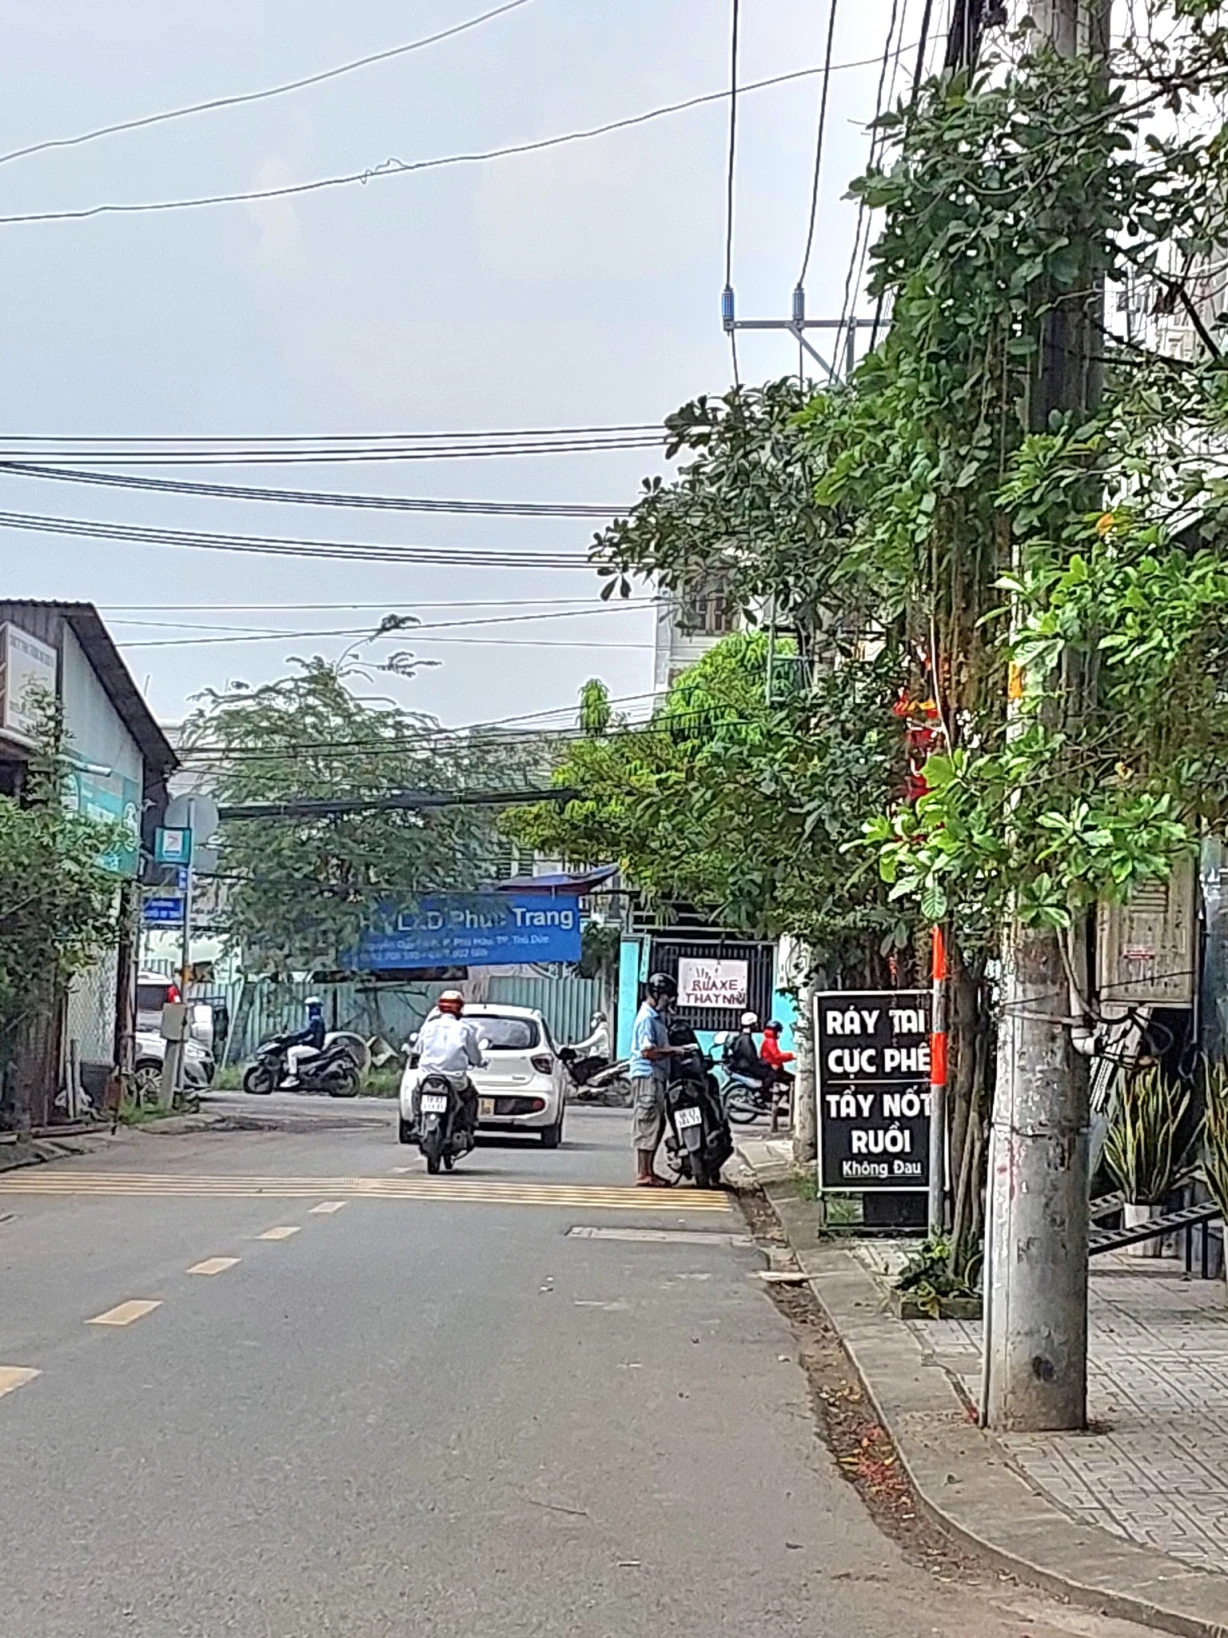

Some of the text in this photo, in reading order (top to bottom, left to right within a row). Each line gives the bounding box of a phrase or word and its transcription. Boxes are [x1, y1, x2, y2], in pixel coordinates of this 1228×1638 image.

[512, 908, 573, 930] Trang
[826, 1005, 926, 1034] RÁY TAI
[828, 1042, 931, 1079] CỰC PHÊ
[825, 1085, 931, 1118] TẨY NỐT
[851, 1121, 911, 1154] RUỒI
[843, 1159, 922, 1178] Không Đau
